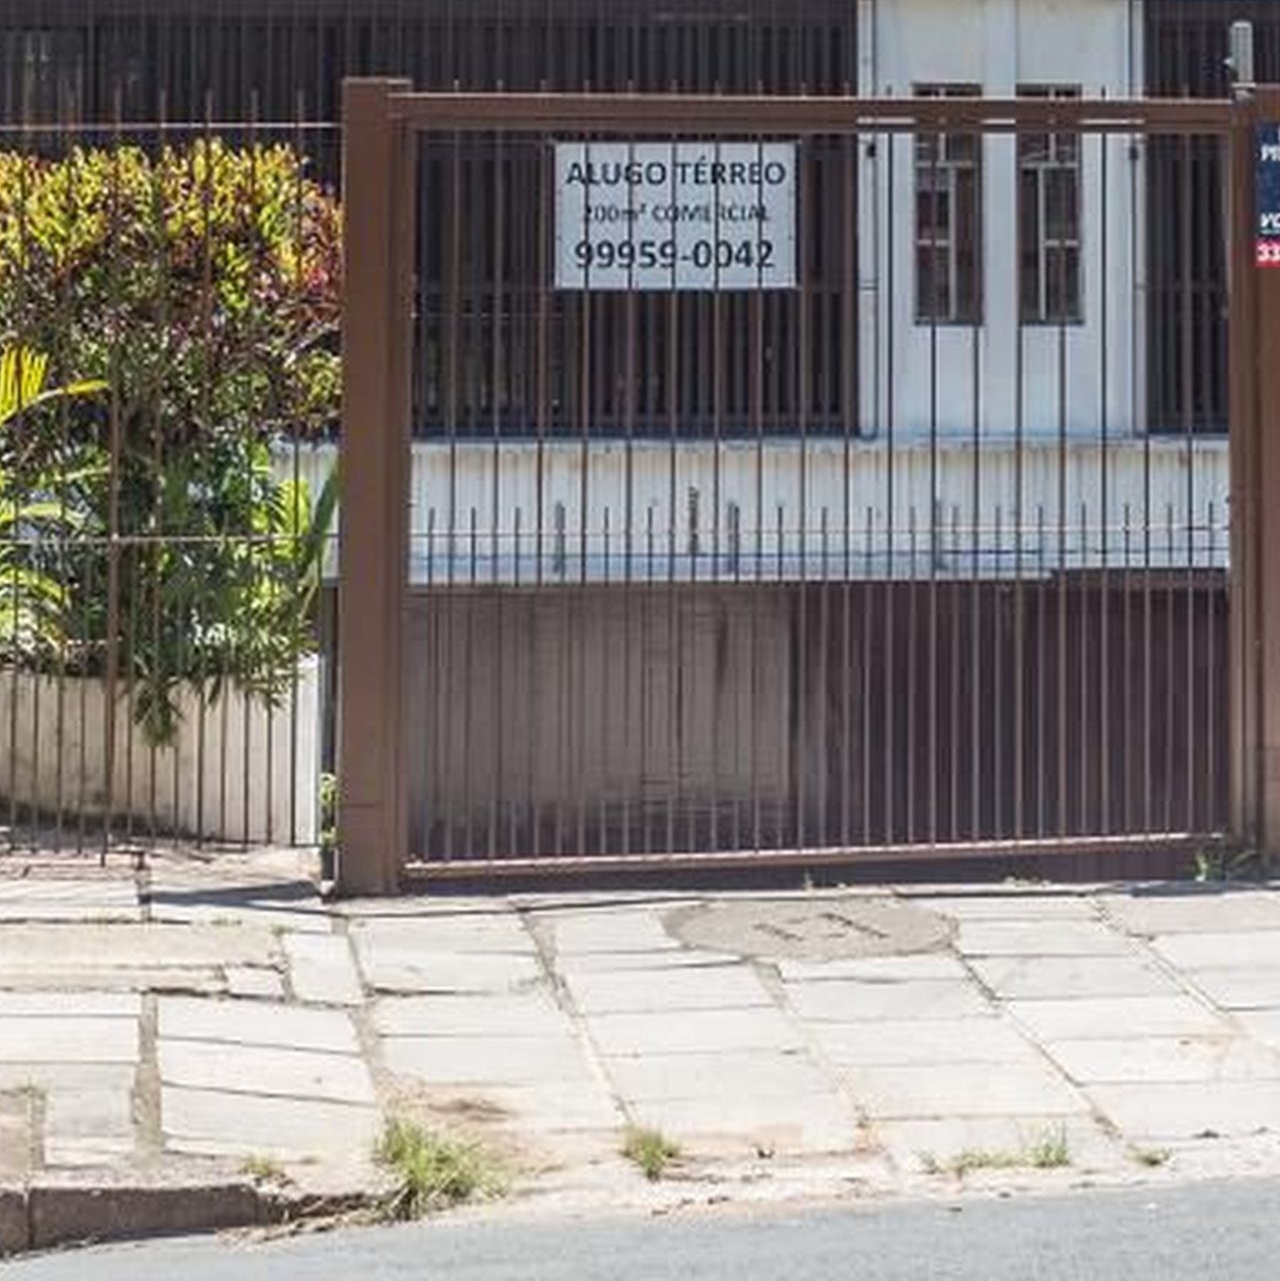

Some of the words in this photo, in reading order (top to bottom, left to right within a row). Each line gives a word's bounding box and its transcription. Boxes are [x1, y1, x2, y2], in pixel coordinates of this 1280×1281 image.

[565, 162, 667, 186] ALUGO
[675, 155, 786, 185] TÉRREO
[651, 204, 771, 222] COMERCIAL
[574, 240, 775, 269] 99959-0042
